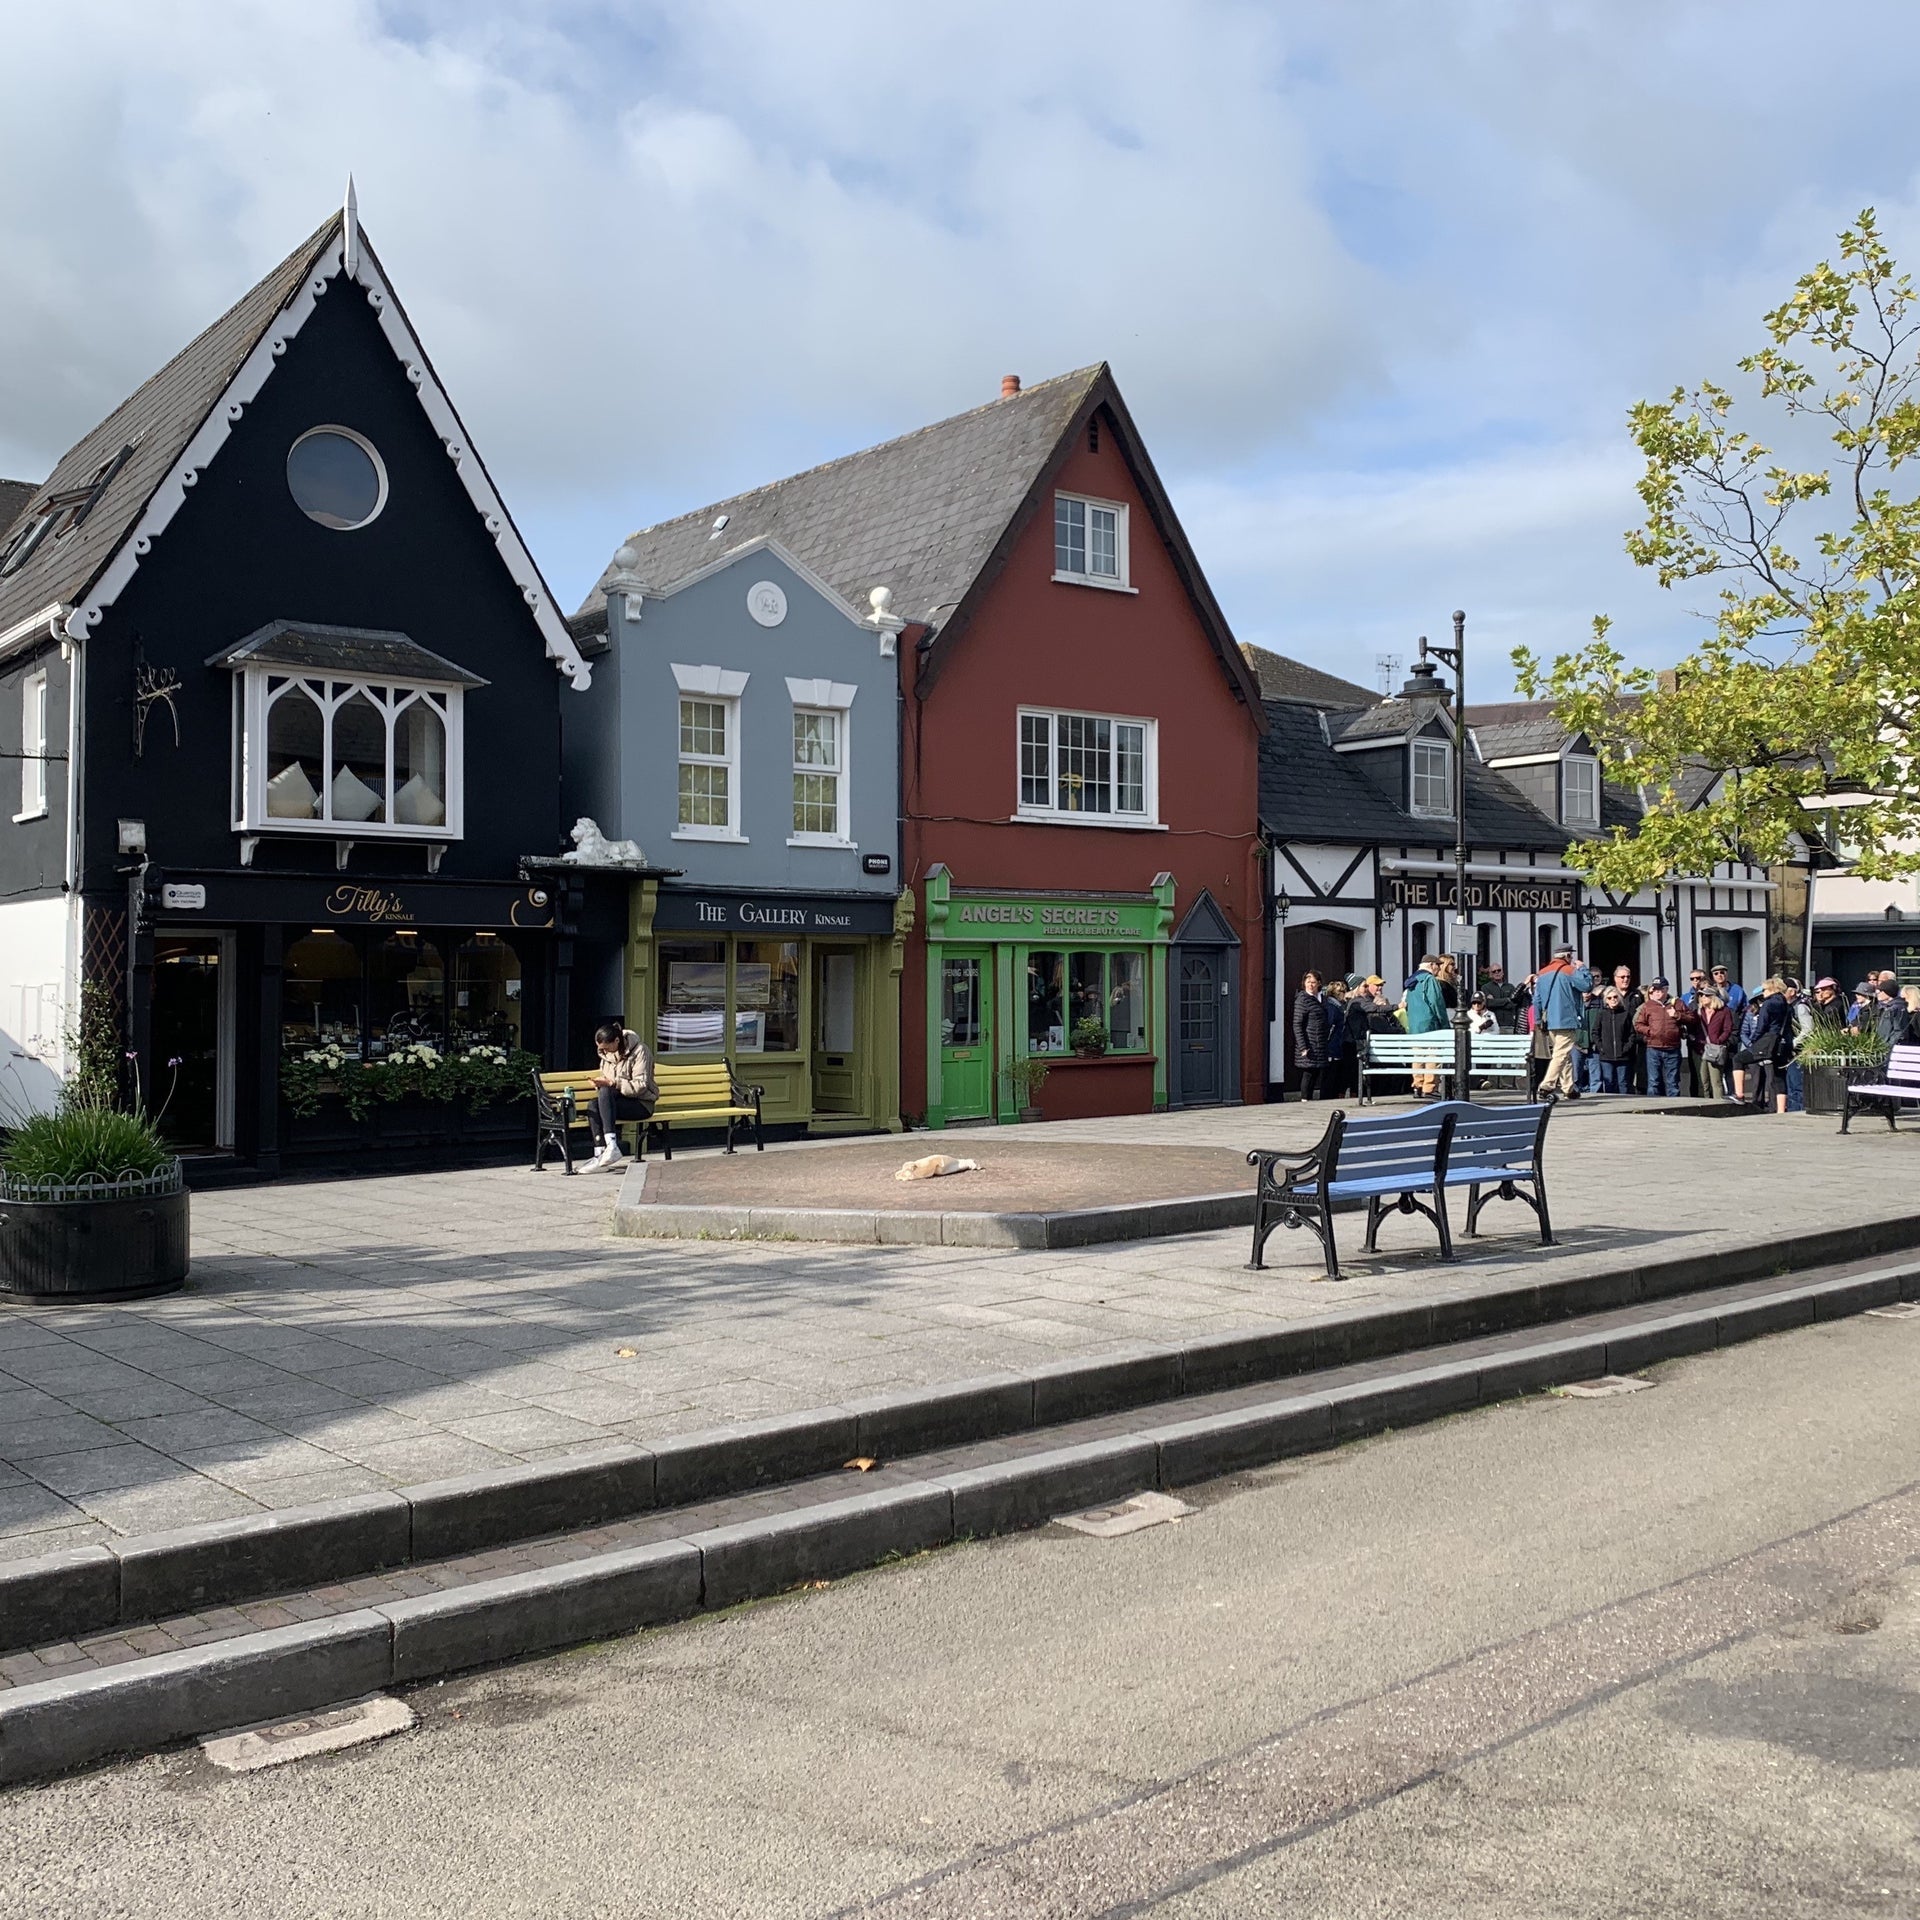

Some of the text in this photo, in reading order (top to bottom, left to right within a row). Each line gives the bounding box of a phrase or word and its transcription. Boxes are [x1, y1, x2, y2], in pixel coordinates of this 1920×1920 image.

[325, 885, 403, 922] Tilly's
[1390, 879, 1429, 905] THE
[1488, 882, 1573, 910] KINGSALE
[384, 913, 415, 921] KINSALE
[695, 901, 851, 926] THE GALLERY KINSALE
[959, 905, 1120, 926] ANGEL'S SECRETS
[1043, 926, 1076, 935] HEALTH
[1086, 926, 1118, 936] BEAUTY
[1119, 927, 1143, 936] CARE
